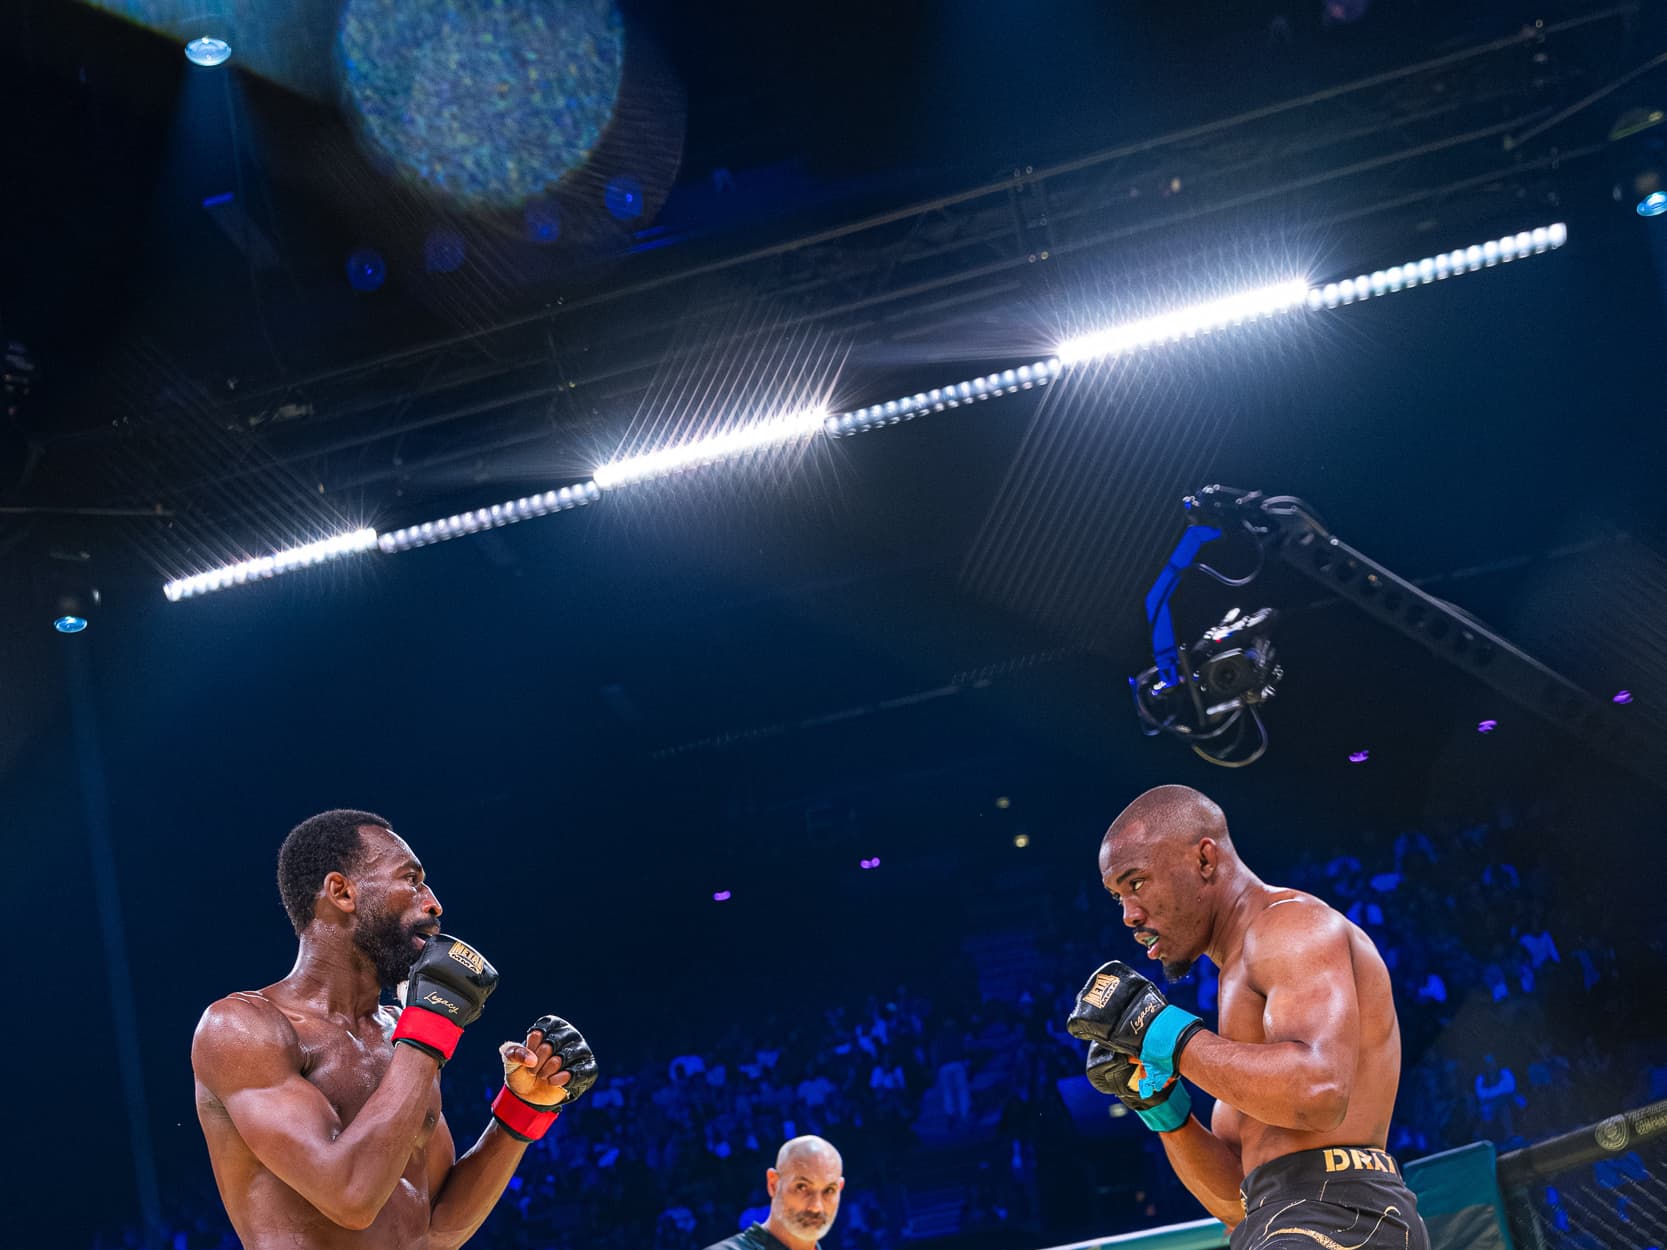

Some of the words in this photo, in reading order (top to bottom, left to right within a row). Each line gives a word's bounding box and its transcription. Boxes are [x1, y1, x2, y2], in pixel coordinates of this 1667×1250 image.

[449, 942, 485, 971] METAL
[449, 953, 481, 974] MMA
[423, 991, 460, 1015] Legacy
[1083, 974, 1117, 1008] METAL
[1101, 978, 1120, 1007] MMA
[1130, 1002, 1157, 1035] Legacy
